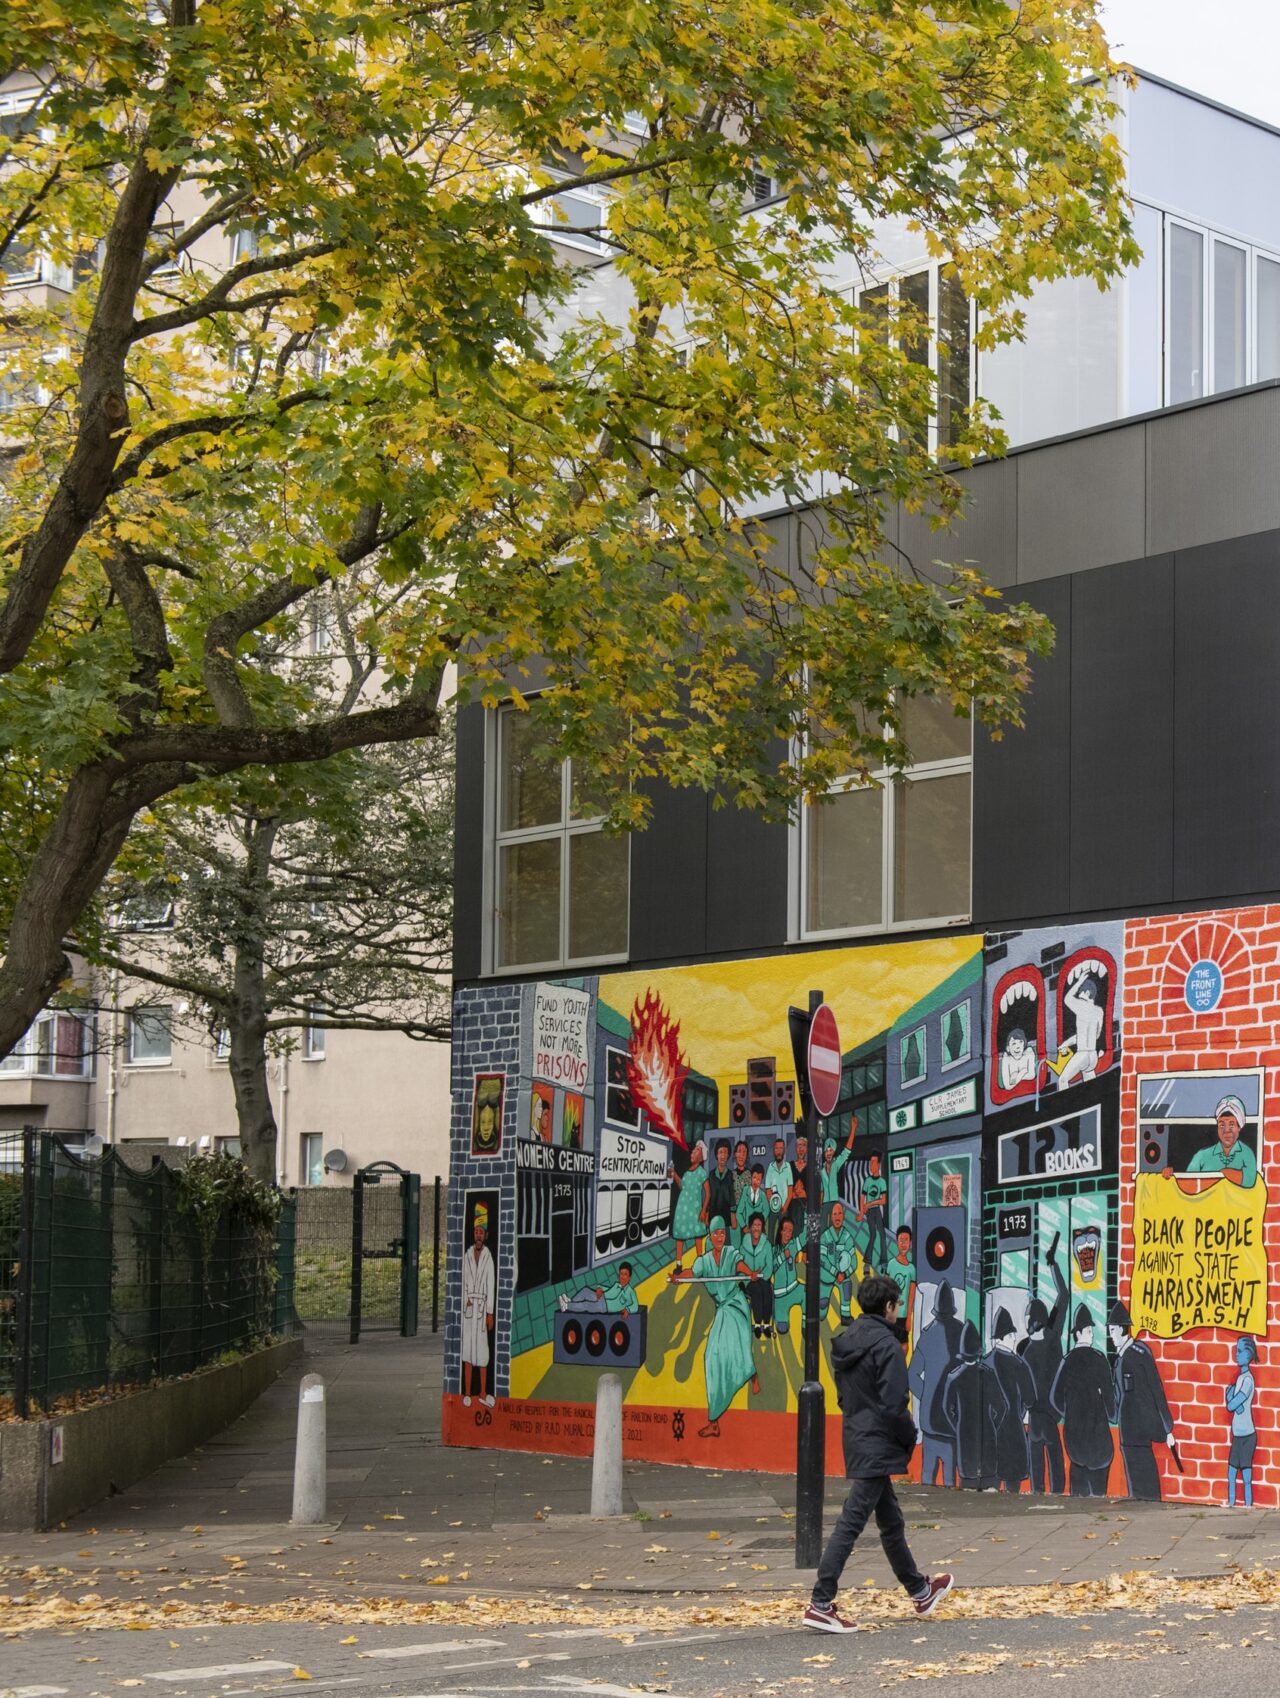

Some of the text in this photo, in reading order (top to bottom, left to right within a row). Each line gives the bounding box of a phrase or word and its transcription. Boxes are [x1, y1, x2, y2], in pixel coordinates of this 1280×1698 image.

[1191, 978, 1216, 990] FRONT
[1195, 969, 1210, 978] THE
[536, 996, 588, 1017] FUND YOUTH
[538, 1015, 583, 1036] SERVICES
[539, 1034, 583, 1059] NOT MORE
[536, 1053, 587, 1087] PRISONS
[947, 1086, 967, 1101] JAMES
[617, 1135, 646, 1158] STOP
[517, 1143, 595, 1173] WOMENS CENTRE
[601, 1156, 665, 1176] GENTRIFICATION
[1045, 1143, 1095, 1175] BOOKS
[554, 1184, 572, 1197] 1973
[1003, 1215, 1027, 1231] 1973
[1143, 1216, 1253, 1251] BLACK PEOPLE
[1138, 1251, 1239, 1281] AGAINST STATE
[1142, 1277, 1261, 1313] HARASSMENT
[1140, 1316, 1158, 1332] 1978
[502, 1403, 515, 1414] WALL
[516, 1405, 522, 1415] OF
[549, 1407, 559, 1417] FOR
[562, 1407, 574, 1417] THE
[653, 1412, 669, 1424] ROAD
[534, 1421, 542, 1434] BY
[564, 1424, 585, 1437] MURAL
[628, 1429, 642, 1441] 2021
